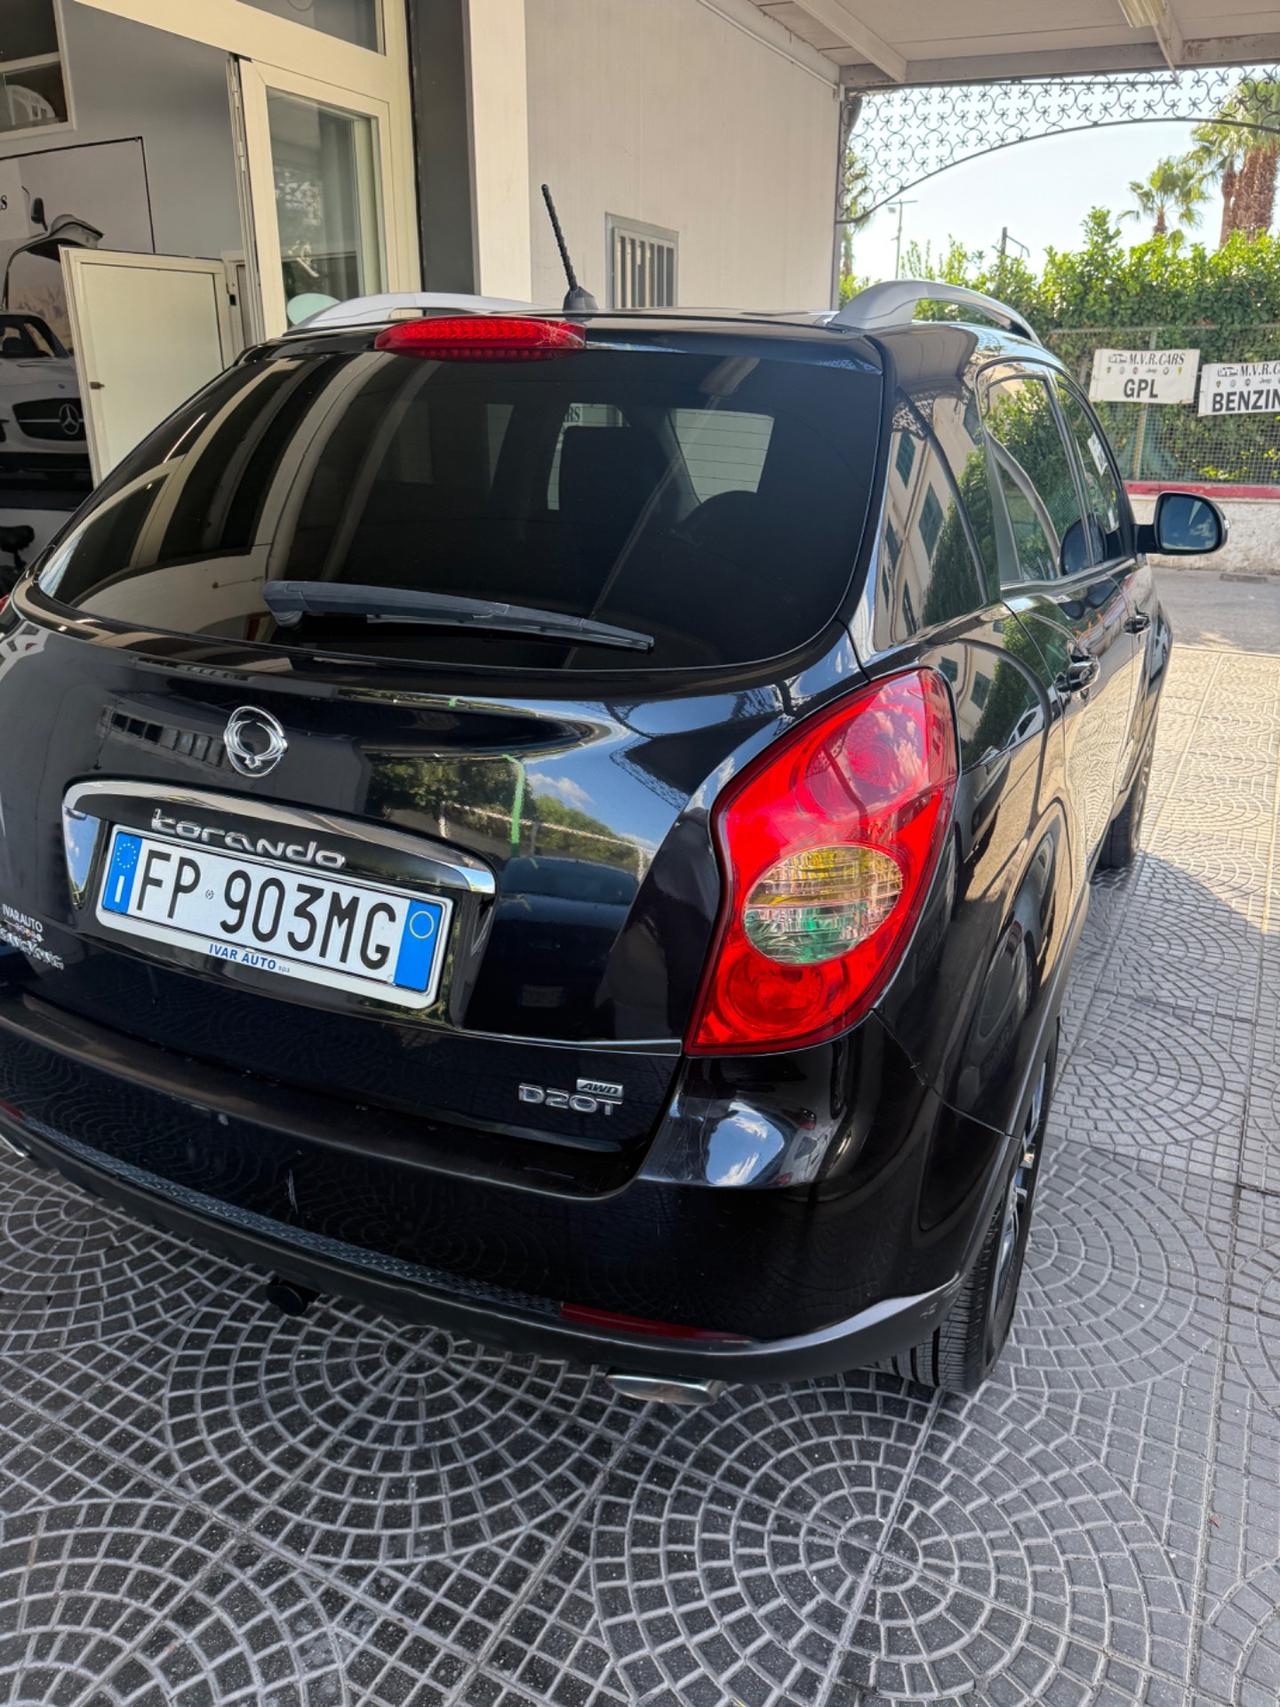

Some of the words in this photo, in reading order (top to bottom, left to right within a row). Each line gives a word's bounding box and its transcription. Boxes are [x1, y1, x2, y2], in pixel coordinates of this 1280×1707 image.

[1123, 378, 1158, 399] GPL
[136, 849, 201, 919] FP
[219, 869, 397, 971] 903MG
[209, 943, 238, 960] IVAR
[241, 953, 277, 970] AUTO
[519, 1084, 622, 1115] D20T
[580, 1082, 618, 1095] AWD
